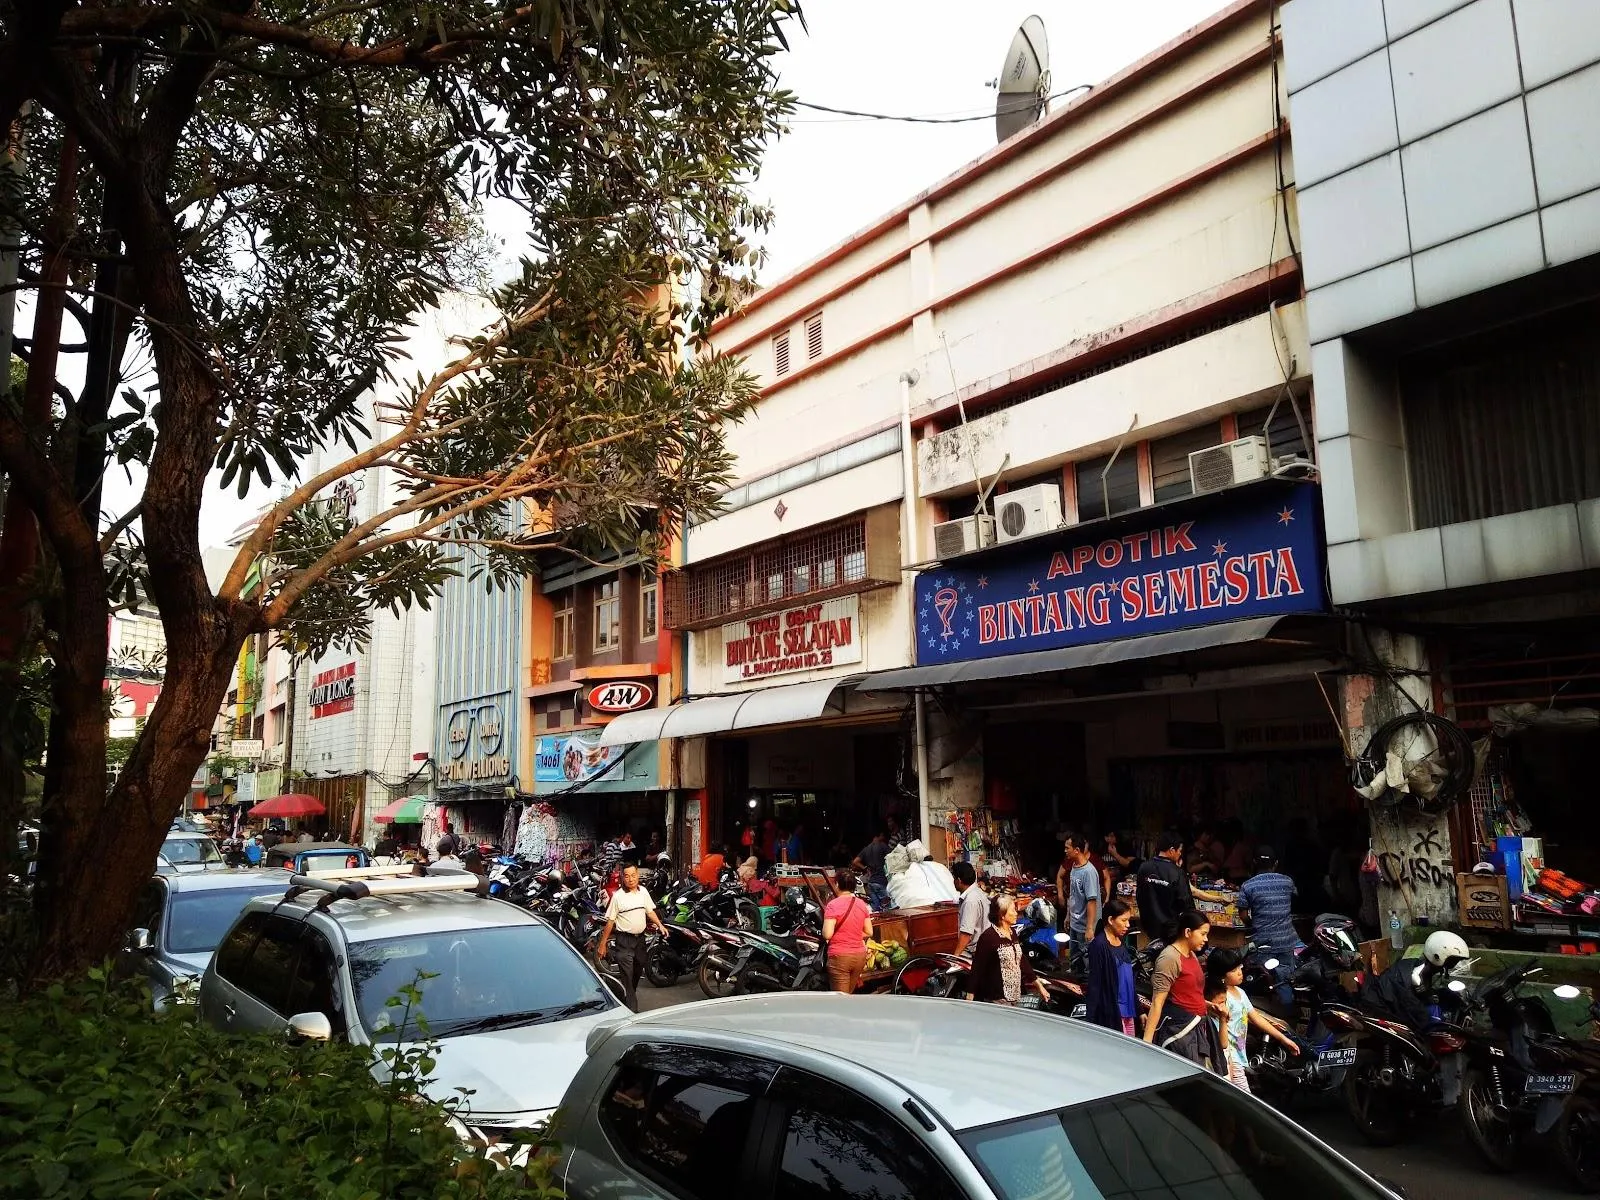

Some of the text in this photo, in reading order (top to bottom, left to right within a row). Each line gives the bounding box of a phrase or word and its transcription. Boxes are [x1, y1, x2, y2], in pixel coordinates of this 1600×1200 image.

[1047, 520, 1198, 580] APOTIK
[786, 603, 822, 628] OBAT
[978, 546, 1305, 645] BINTANG SEMESTA
[725, 617, 852, 667] BINTANG SELATAN
[599, 686, 642, 706] A&W
